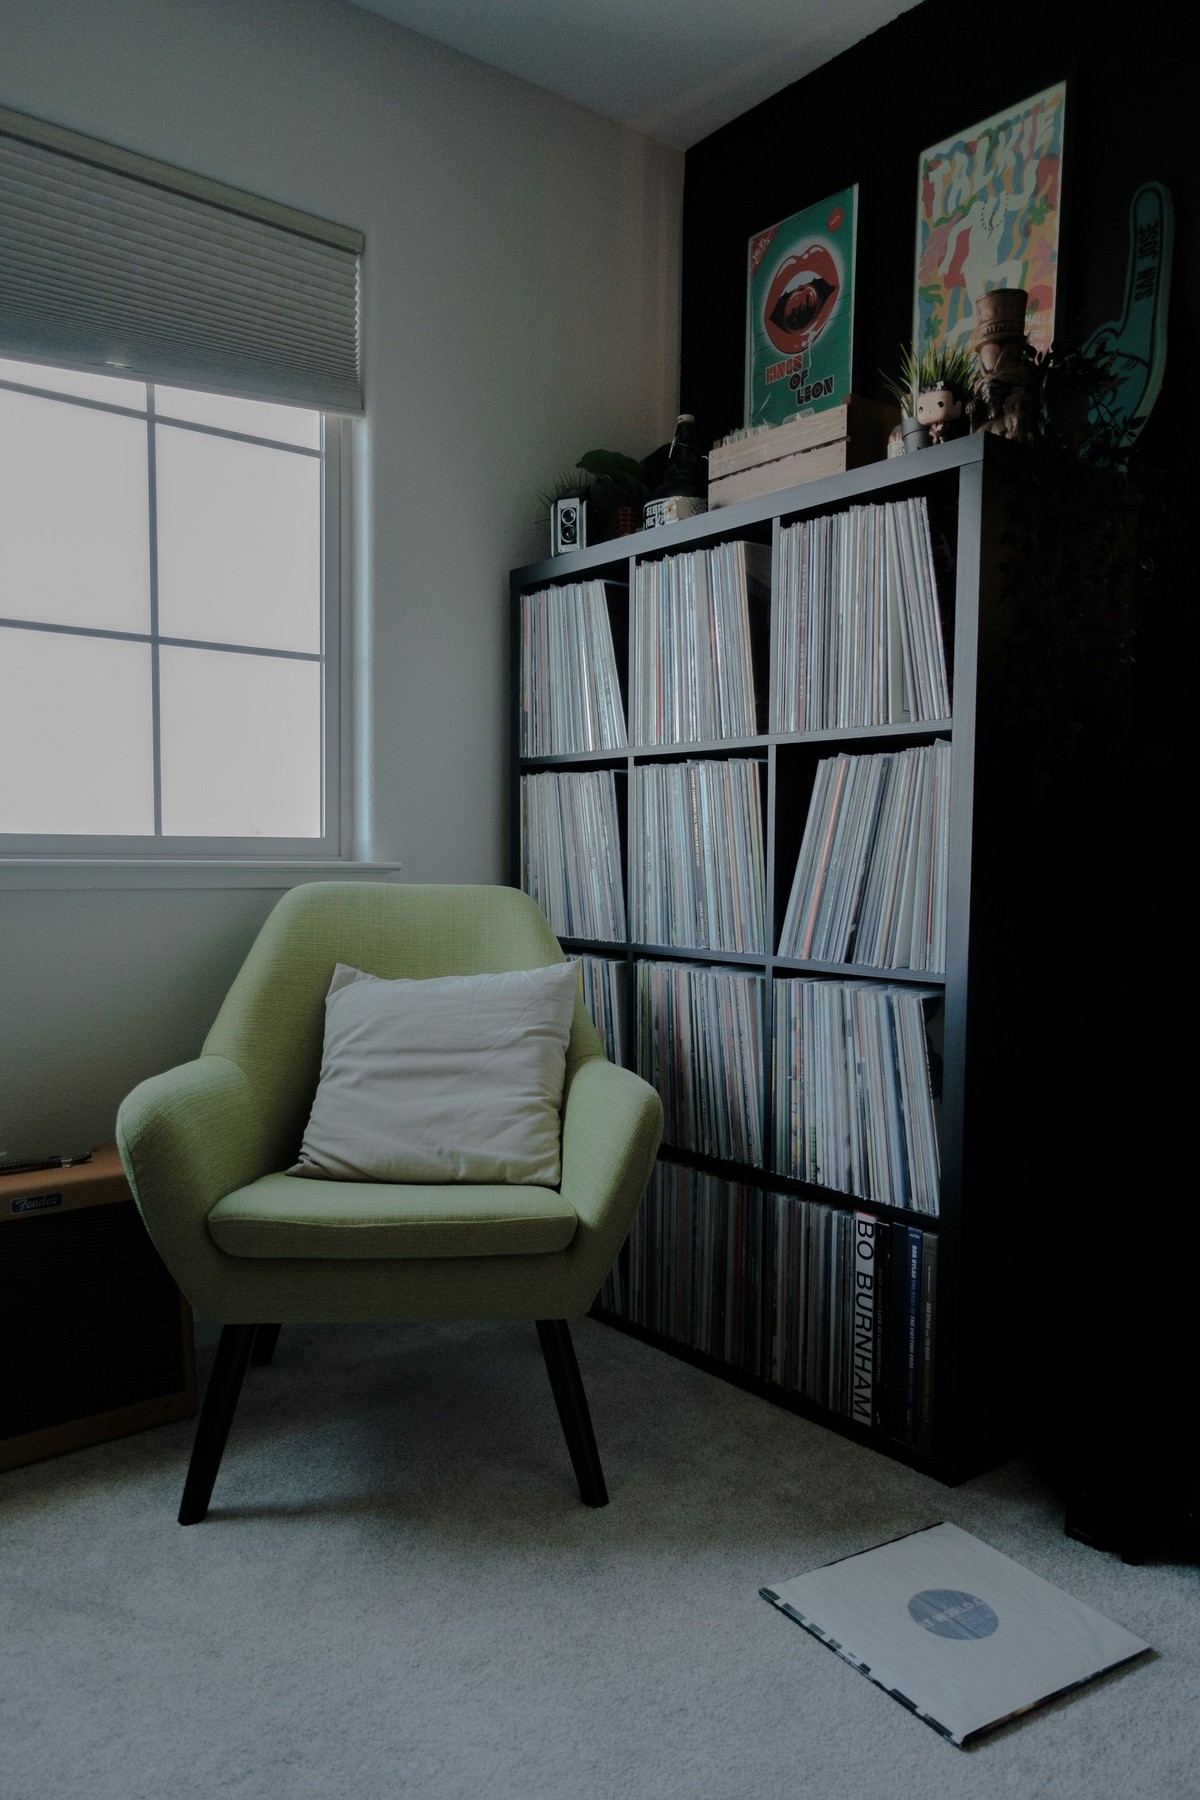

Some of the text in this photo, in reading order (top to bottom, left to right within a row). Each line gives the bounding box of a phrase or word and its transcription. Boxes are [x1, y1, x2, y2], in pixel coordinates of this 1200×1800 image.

[929, 112, 1055, 223] TALKIE
[1135, 218, 1159, 302] SAN JOSE
[765, 354, 803, 385] KINGS
[788, 368, 809, 392] OF
[796, 374, 835, 407] LEON
[15, 1195, 58, 1212] Fender
[854, 1220, 874, 1418] BO BURNHAM
[932, 1601, 975, 1622] WORLD
